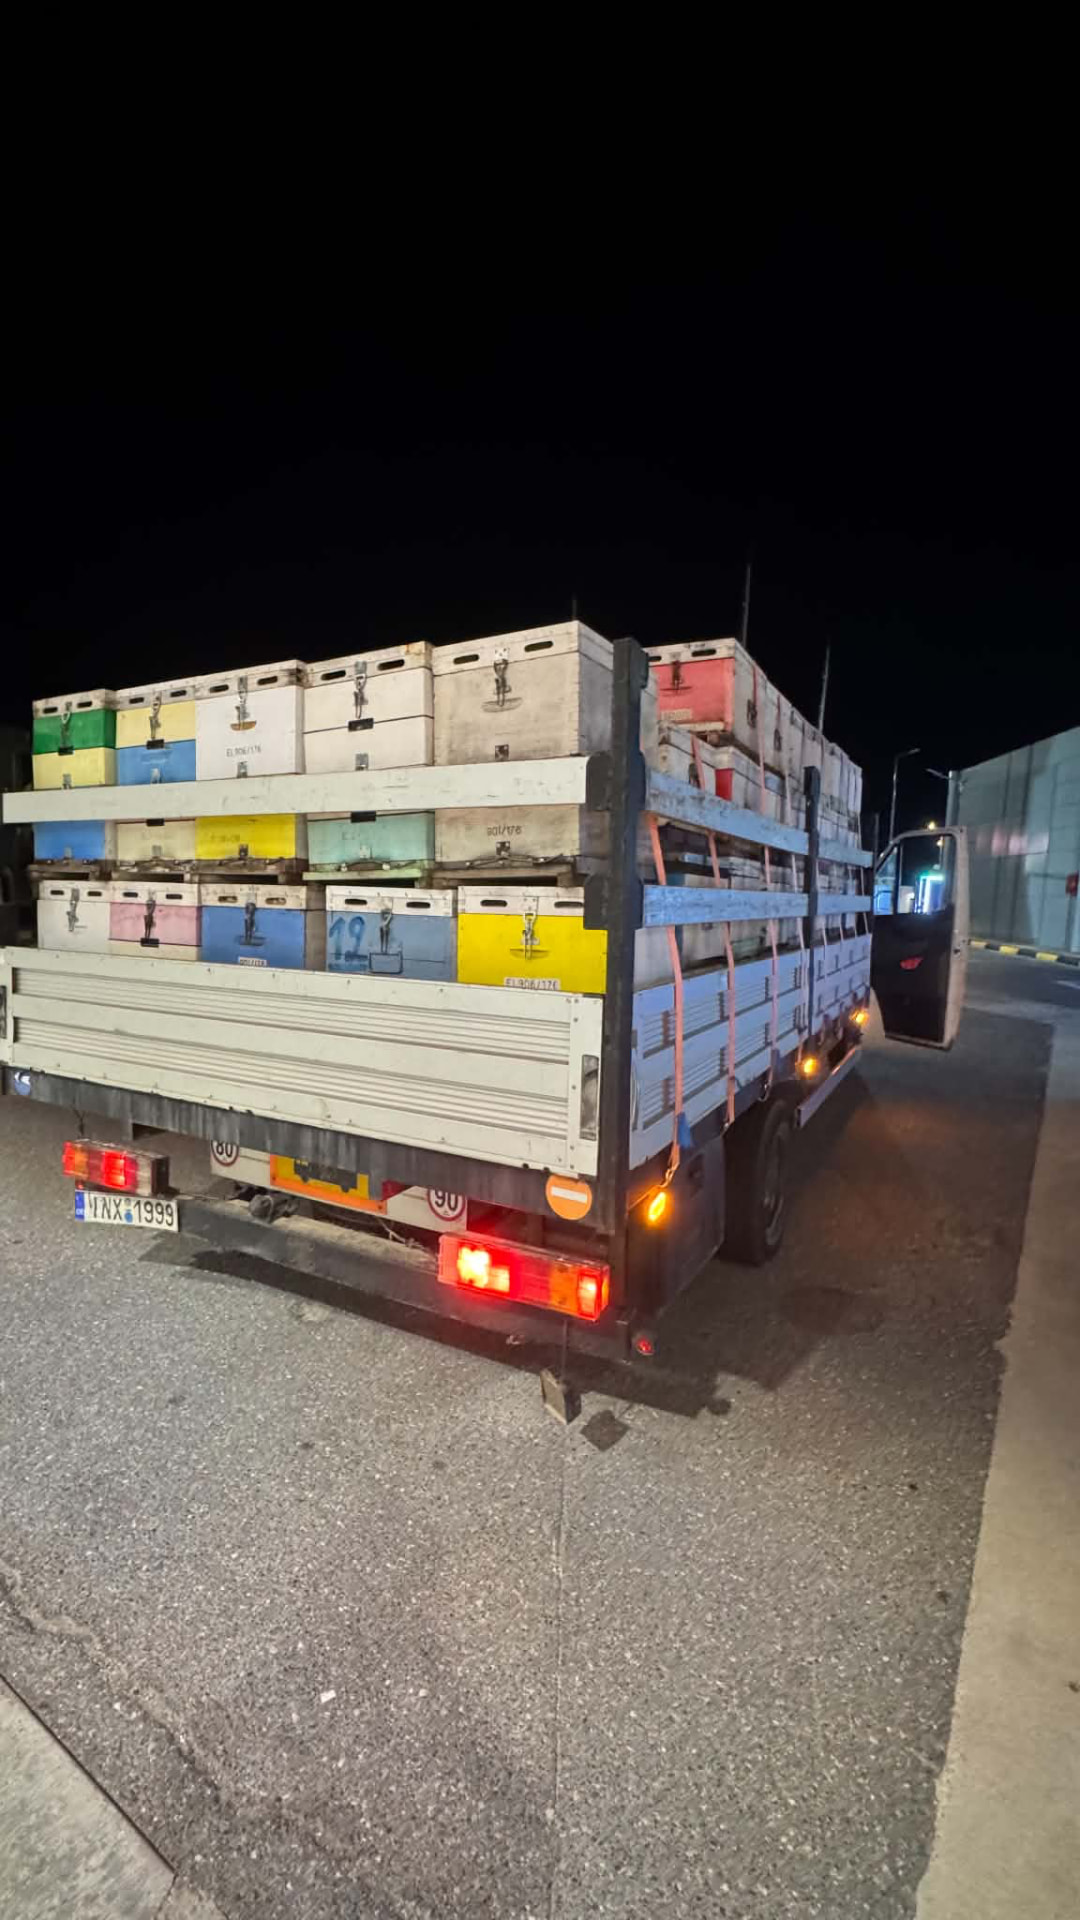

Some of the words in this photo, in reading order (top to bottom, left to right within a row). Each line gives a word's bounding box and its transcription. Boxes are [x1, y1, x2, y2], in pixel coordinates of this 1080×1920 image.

[216, 1141, 233, 1158] 80
[434, 1189, 459, 1212] 90
[133, 1200, 174, 1227] 1999
